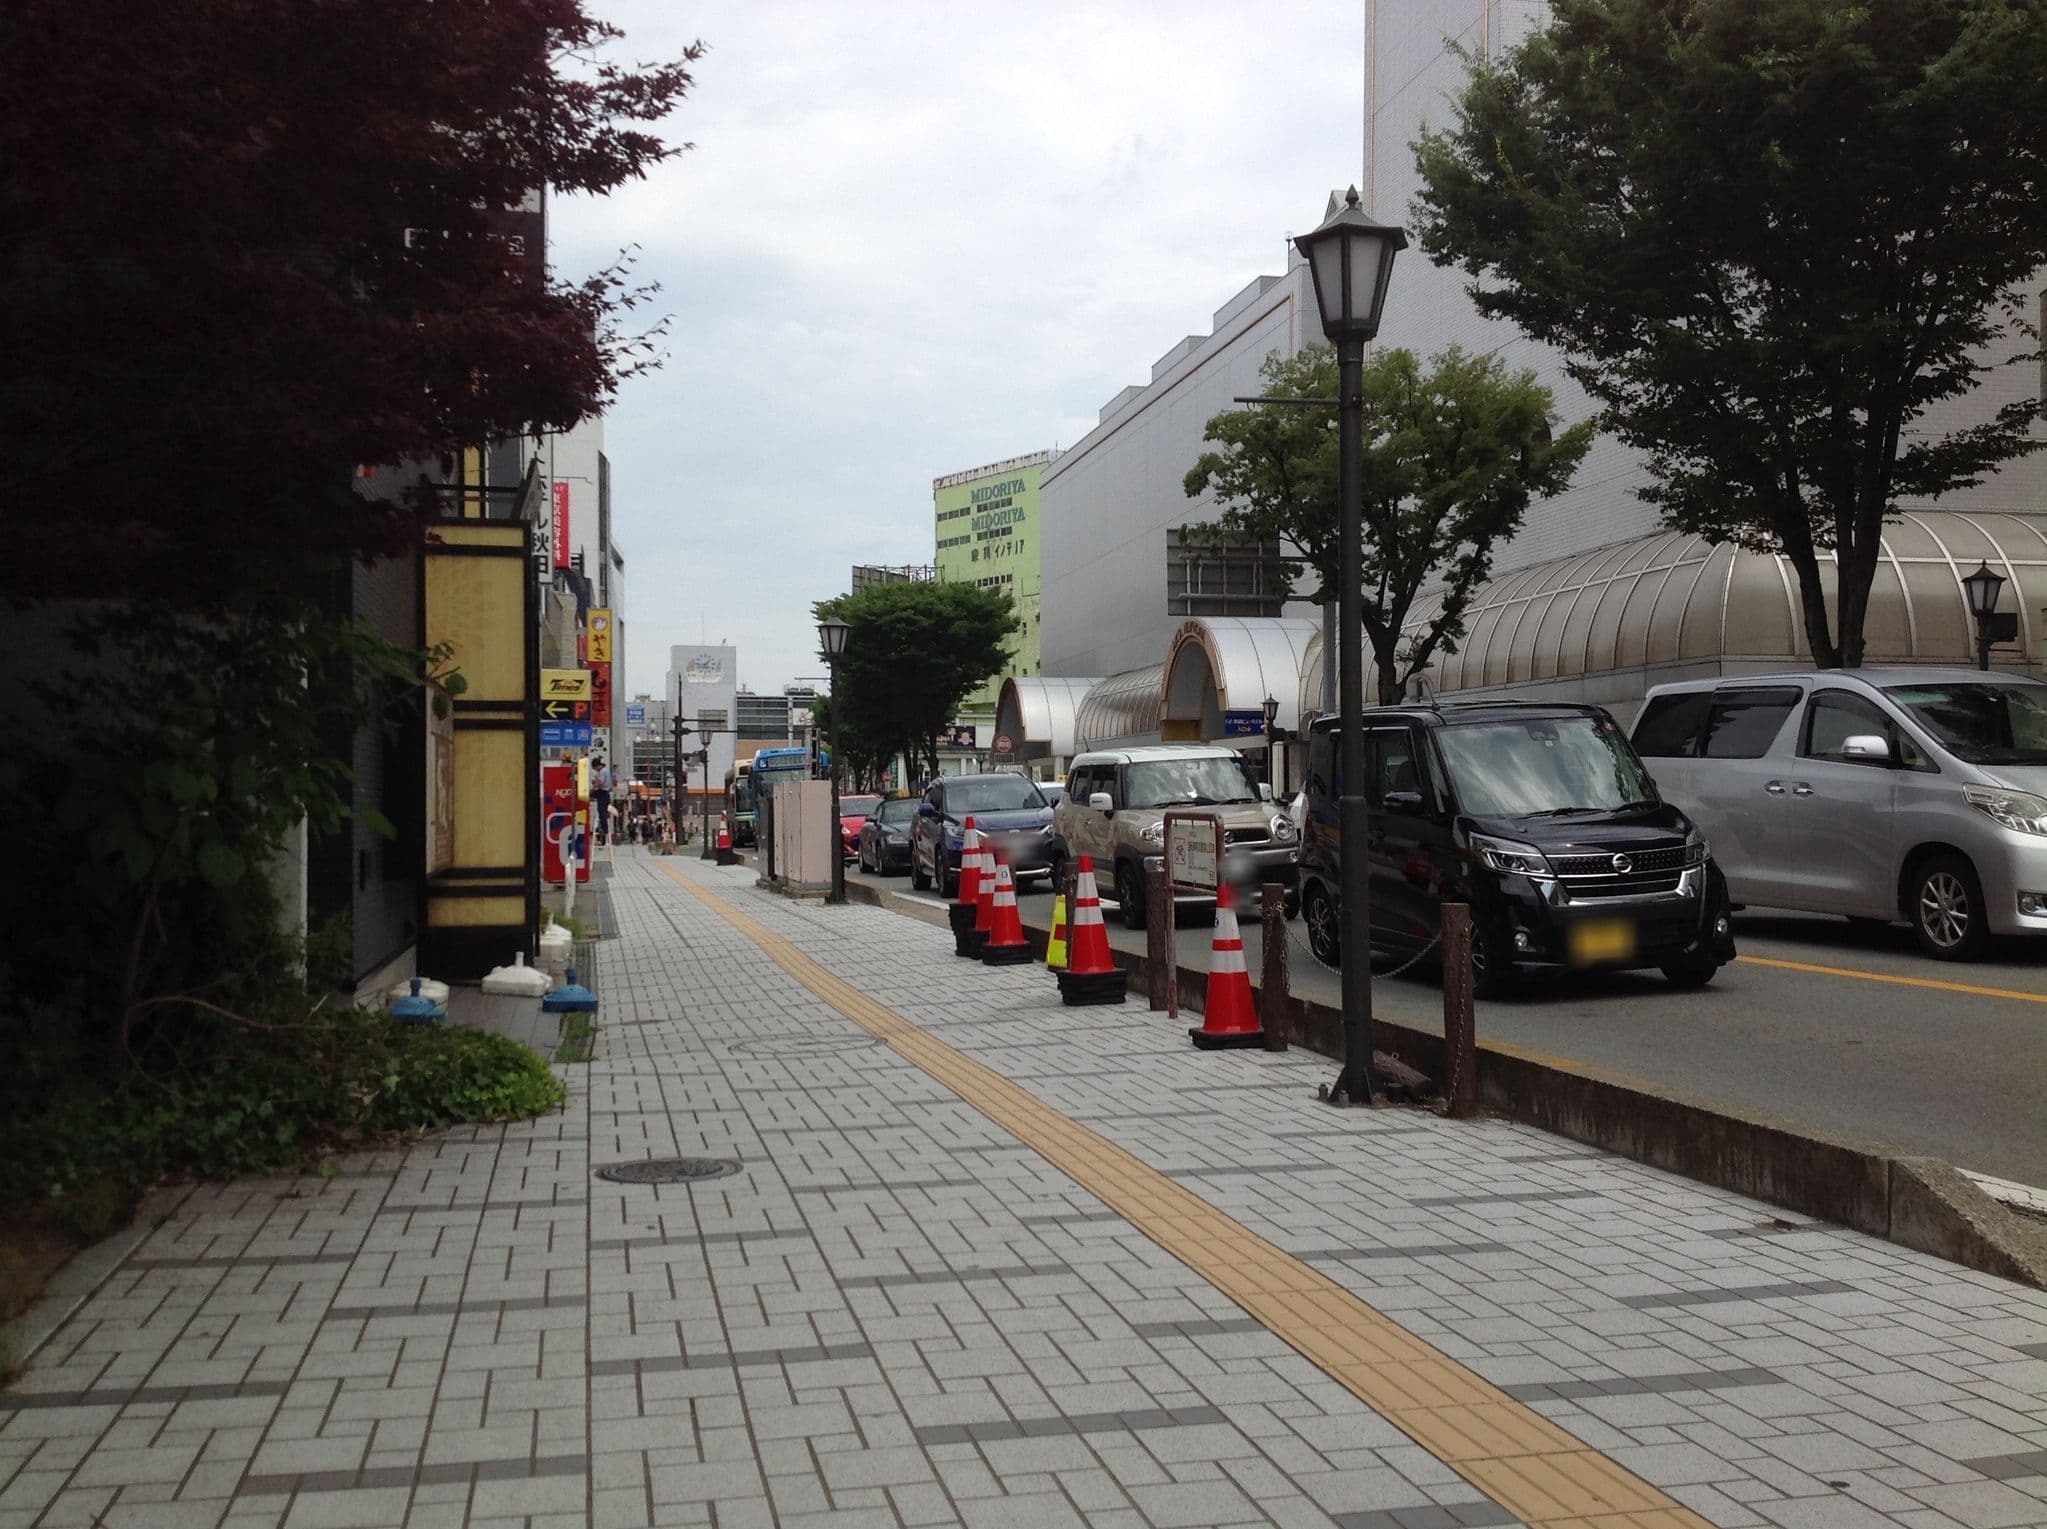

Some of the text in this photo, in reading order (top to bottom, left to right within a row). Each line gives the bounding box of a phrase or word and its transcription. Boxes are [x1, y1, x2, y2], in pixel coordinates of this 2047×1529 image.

[971, 478, 1025, 503] MIDORIYA
[971, 507, 1025, 531] MIDORIYA
[550, 678, 585, 691] Times
